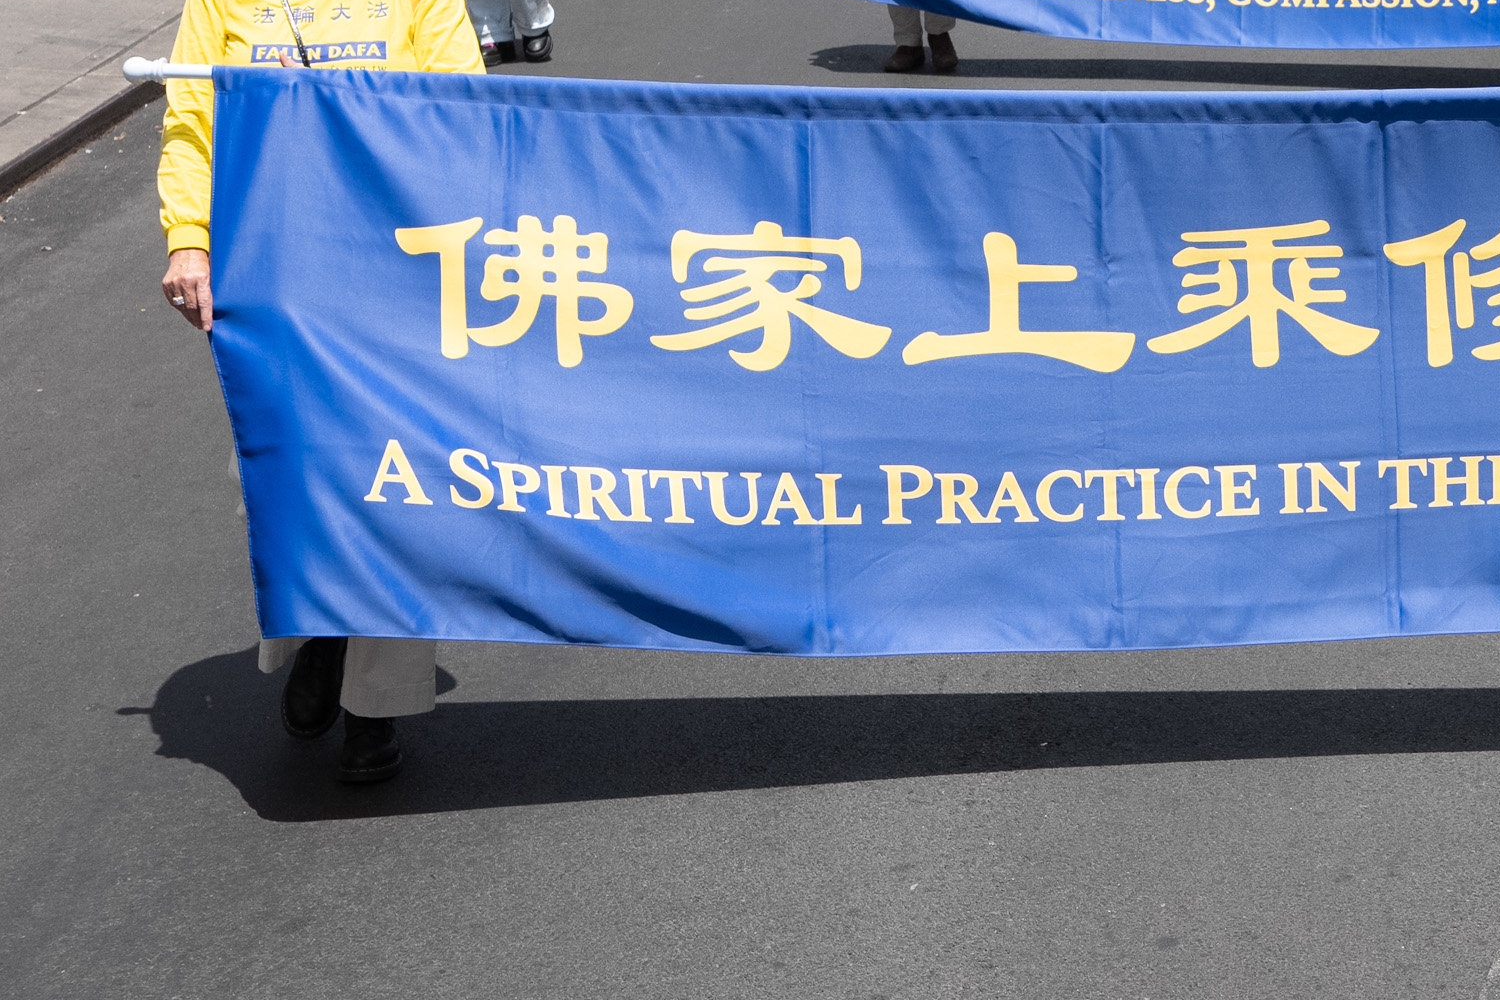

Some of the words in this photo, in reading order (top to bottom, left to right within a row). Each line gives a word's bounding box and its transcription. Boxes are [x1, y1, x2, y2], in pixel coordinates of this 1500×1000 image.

[253, 1, 390, 25] 法輪大法
[255, 45, 321, 61] FALUN
[327, 43, 382, 59] DAFA
[365, 439, 432, 505] A
[449, 448, 862, 526] SPIRITUAL
[880, 463, 1260, 525] PRACTICE
[1278, 460, 1360, 514] IN
